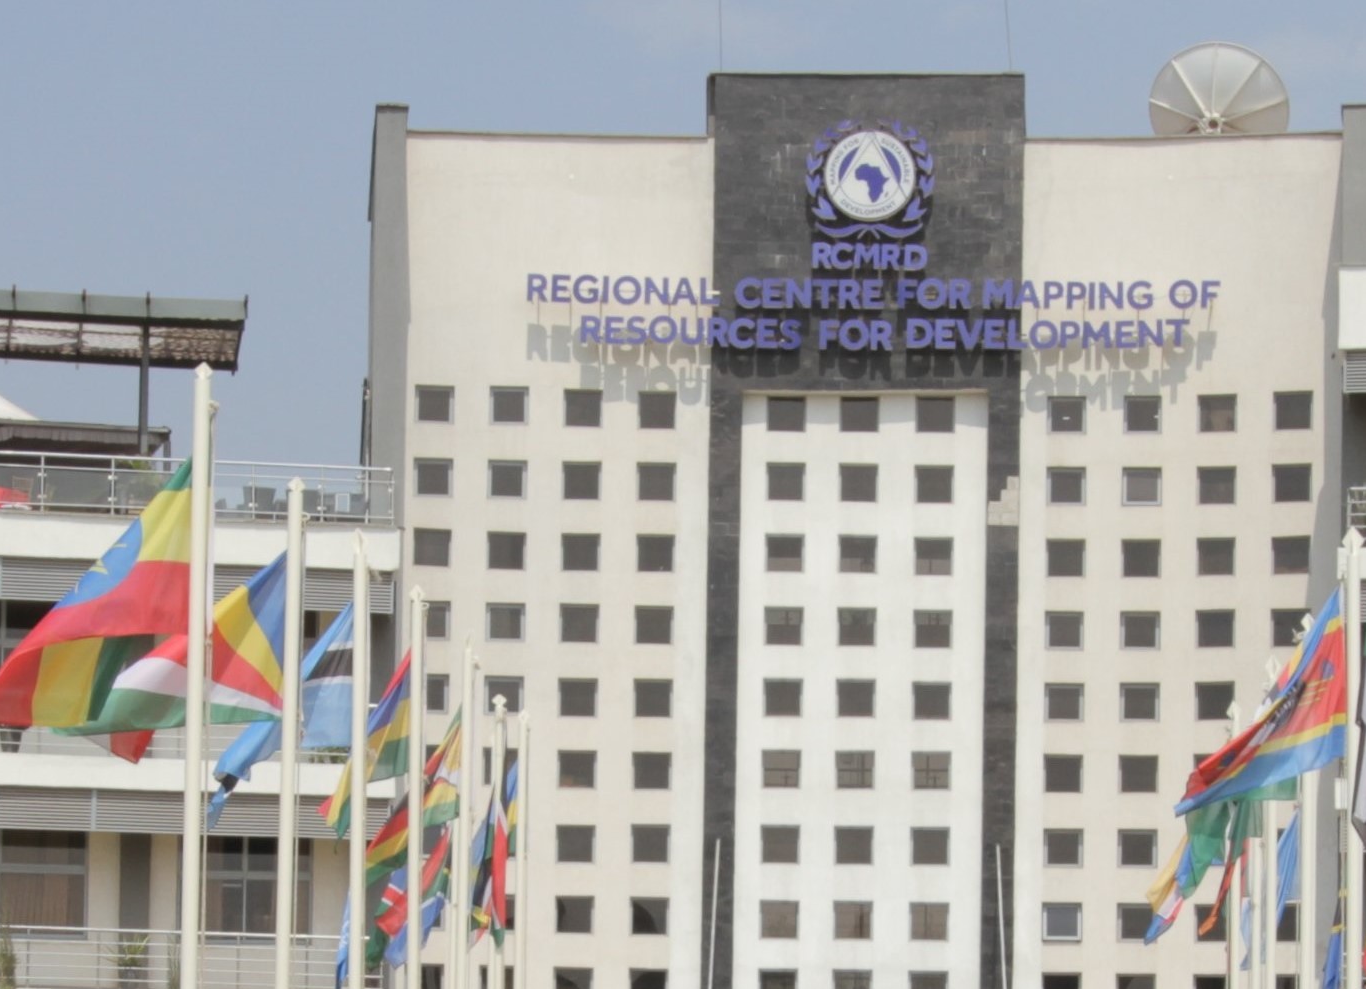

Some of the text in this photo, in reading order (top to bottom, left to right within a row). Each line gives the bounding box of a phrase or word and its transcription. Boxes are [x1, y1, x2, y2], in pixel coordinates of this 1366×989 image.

[829, 138, 860, 185] MAPPING FOR
[881, 138, 910, 183] SUSTAINABLE
[840, 199, 897, 215] DEVELOPMENT
[811, 242, 928, 271] RCMRD
[526, 273, 1221, 311] REGIONAL CENTRE FOR MAPPING OF
[580, 315, 1191, 351] RESOURCES FOR DEVELOPMENT
